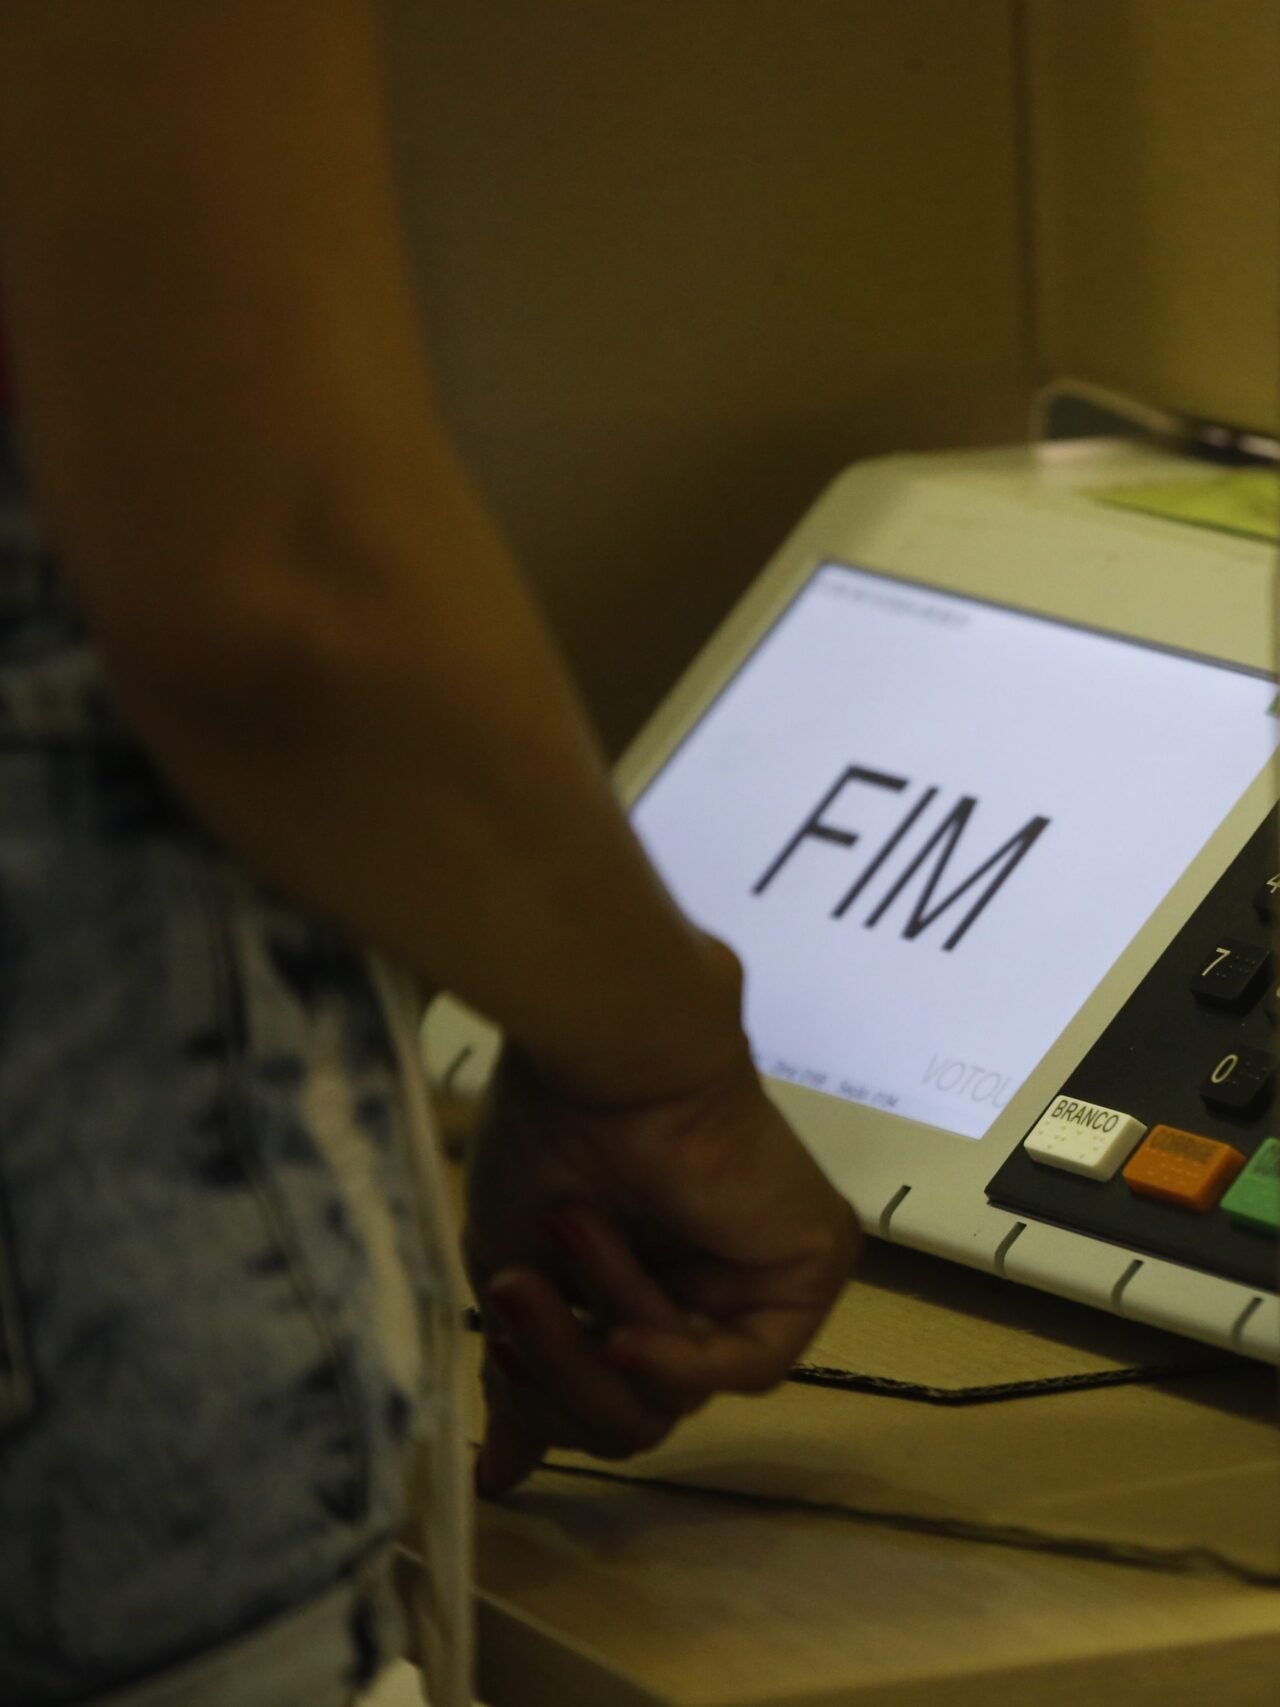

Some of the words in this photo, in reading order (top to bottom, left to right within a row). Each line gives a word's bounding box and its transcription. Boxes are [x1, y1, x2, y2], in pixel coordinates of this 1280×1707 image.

[752, 764, 1051, 952] FIM
[1202, 947, 1231, 976] 7
[1211, 1054, 1238, 1084] 0
[1051, 1099, 1119, 1133] BRANCO
